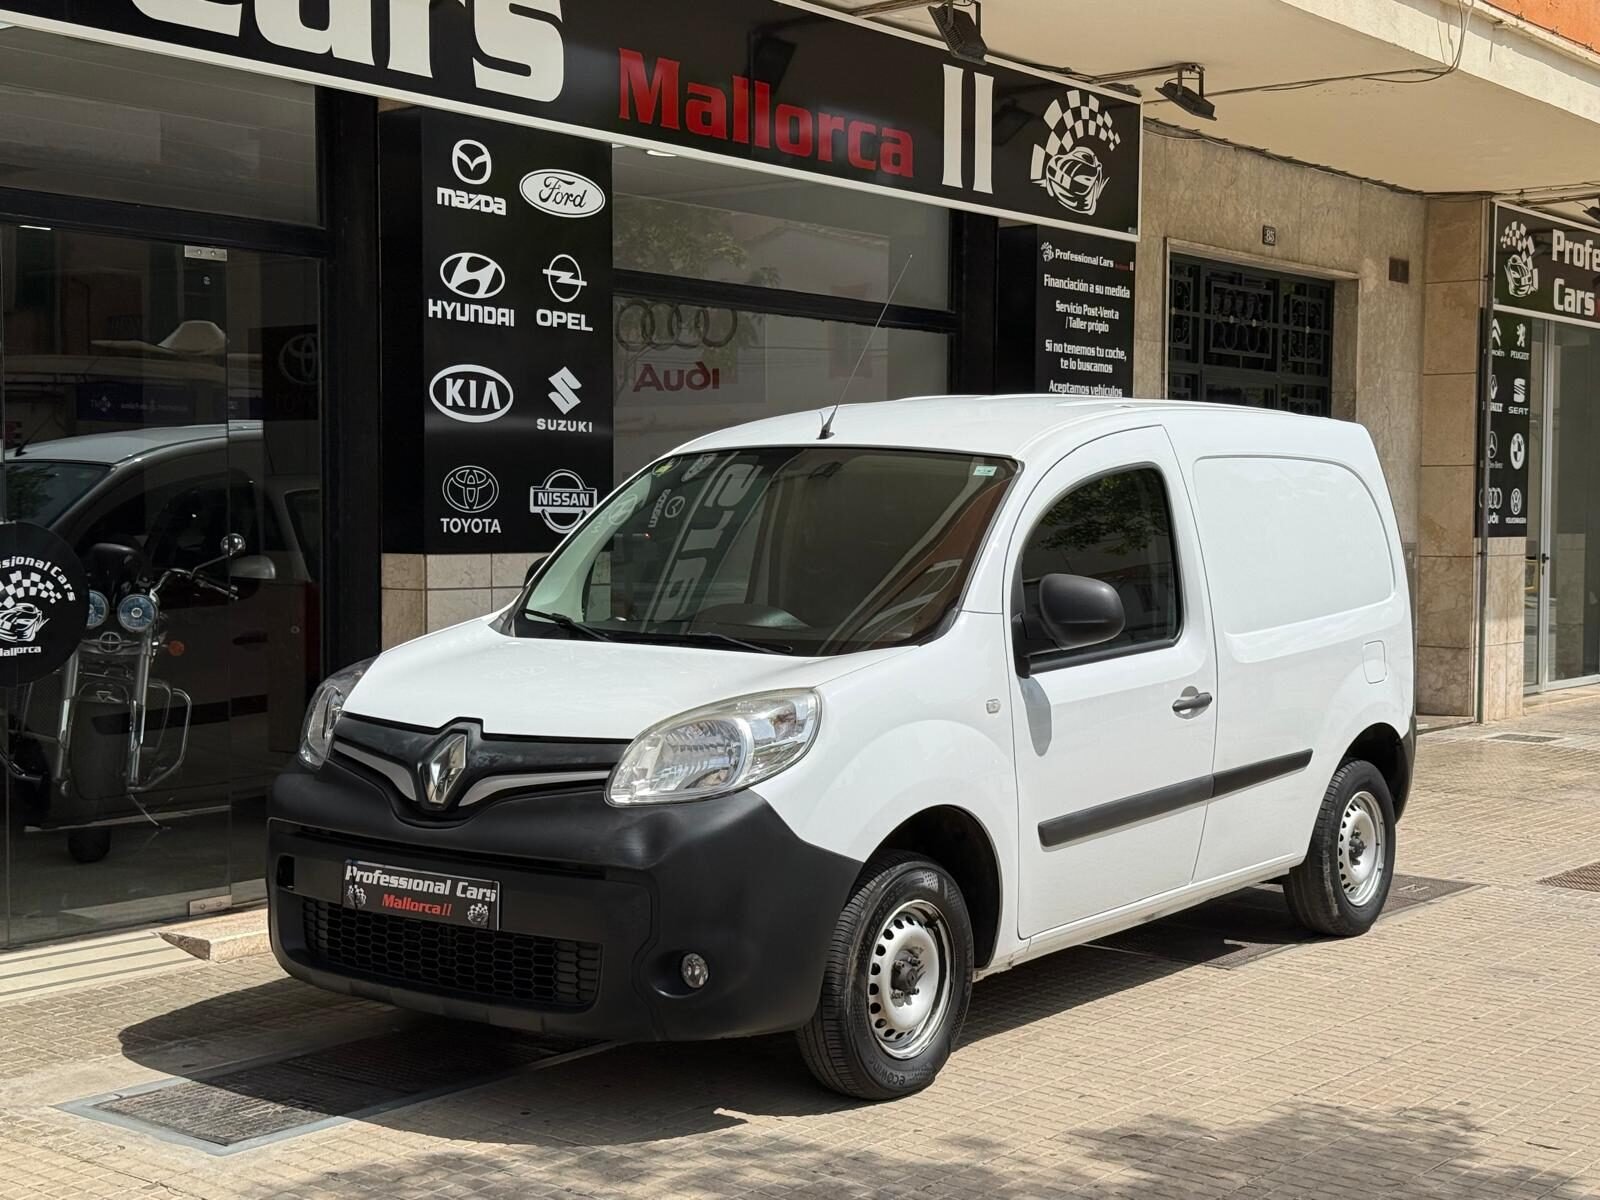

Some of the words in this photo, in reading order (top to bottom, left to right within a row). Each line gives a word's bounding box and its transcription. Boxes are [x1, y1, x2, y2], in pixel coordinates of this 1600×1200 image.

[132, 0, 565, 102] ars
[617, 47, 914, 178] Mallorca
[538, 175, 588, 208] Ford
[1055, 248, 1099, 266] Professional
[1100, 256, 1115, 268] Cars
[1044, 274, 1089, 293] Financiación
[1089, 283, 1095, 293] a
[1095, 284, 1104, 295] su
[1104, 285, 1131, 299] medida
[1553, 278, 1595, 317] Cars
[428, 298, 515, 327] HYUNDAI
[536, 308, 594, 332] OPEL
[1055, 300, 1083, 315] Servicio
[1083, 303, 1120, 320] Post-Venta
[1069, 316, 1087, 330] Taller
[1045, 339, 1053, 352] Si
[1053, 342, 1063, 353] no
[1064, 342, 1096, 357] tenemos
[1096, 346, 1105, 358] tu
[1105, 347, 1127, 362] coche,
[632, 361, 720, 393] Audi
[1060, 357, 1069, 370] te
[1069, 357, 1077, 370] lo
[1077, 358, 1113, 374] buscamos
[445, 378, 501, 410] KIA
[1048, 379, 1090, 395] Aceptamos
[1508, 406, 1529, 415] SEAT
[536, 418, 593, 433] SUZUKI
[537, 492, 590, 507] NISSAN
[440, 517, 502, 534] TOYOTA
[50, 566, 76, 602] Cars
[345, 865, 452, 896] Professional
[382, 894, 441, 916] Mallorca
